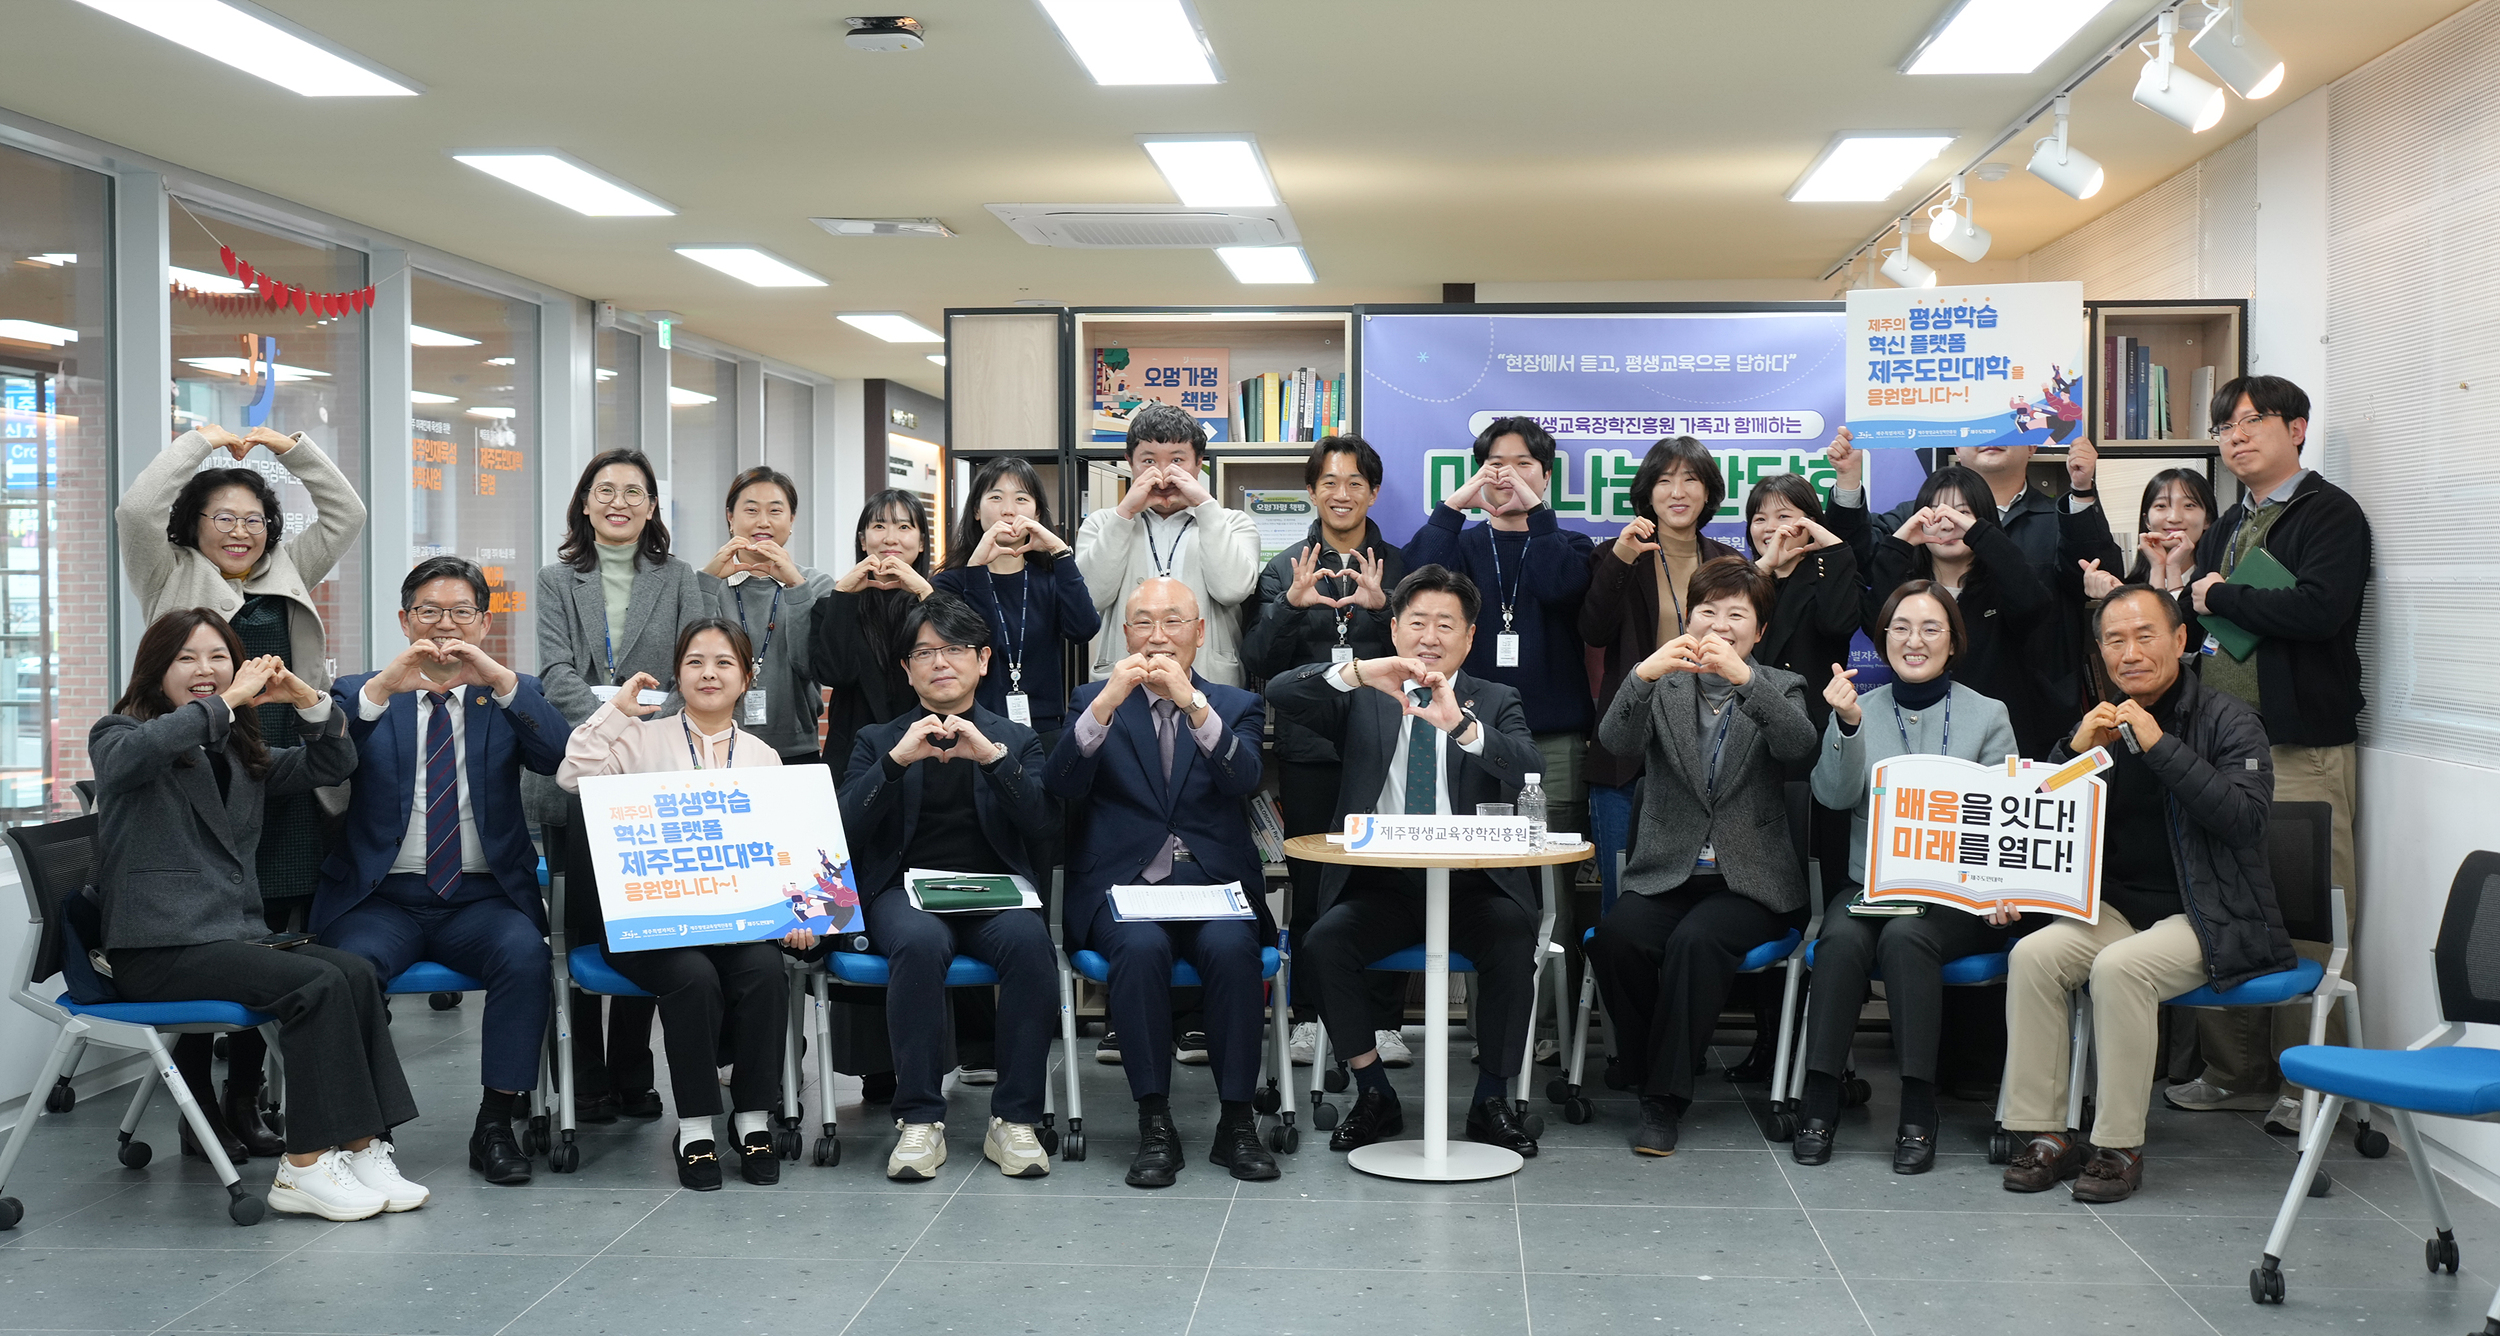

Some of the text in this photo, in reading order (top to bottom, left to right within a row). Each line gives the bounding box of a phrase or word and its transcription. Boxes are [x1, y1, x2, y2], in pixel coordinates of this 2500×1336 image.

[1868, 304, 1998, 332] 제주의 평생학습
[1868, 333, 1966, 355] 혁신 플랫폼
[1580, 355, 1621, 373] 듣고,
[1625, 354, 1731, 373] 평생교육으로
[1144, 367, 1218, 387] 오멍가멍
[1181, 391, 1218, 412] 책방
[1867, 386, 1969, 406] 응원합니다~!
[1679, 416, 1730, 434] 가족과
[1734, 415, 1802, 434] 함께하는
[481, 473, 496, 496] 운영
[609, 788, 751, 821] 제주의 평생학습
[1895, 787, 2076, 833] 배움을 잇다!
[613, 819, 723, 846] 혁신 플랫폼
[1380, 825, 1527, 842] 제주평생교육장학진흥원
[1893, 826, 2073, 873] 미래를 열다!
[624, 875, 739, 902] 응원합니다~!
